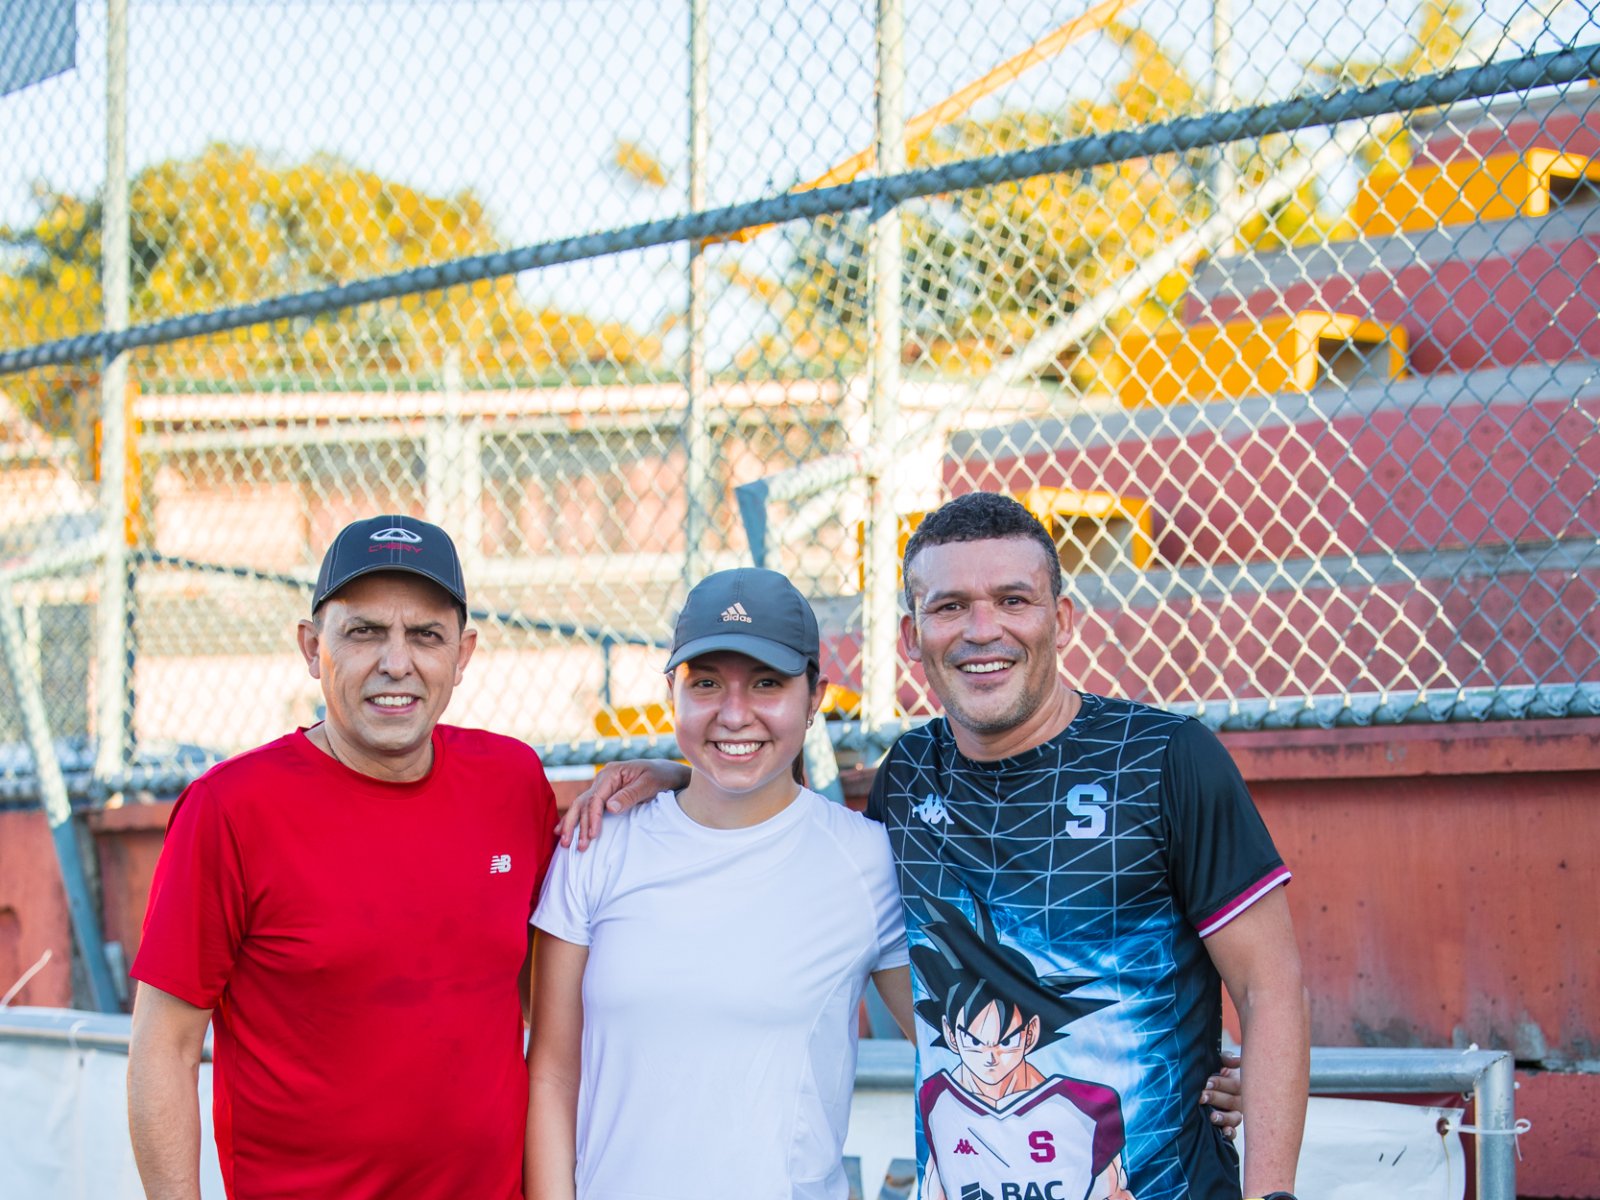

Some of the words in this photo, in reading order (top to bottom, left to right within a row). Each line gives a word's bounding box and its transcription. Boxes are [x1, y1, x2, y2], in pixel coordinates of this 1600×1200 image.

[717, 613, 753, 624] adidas
[1065, 784, 1108, 839] S
[1028, 1130, 1056, 1163] S
